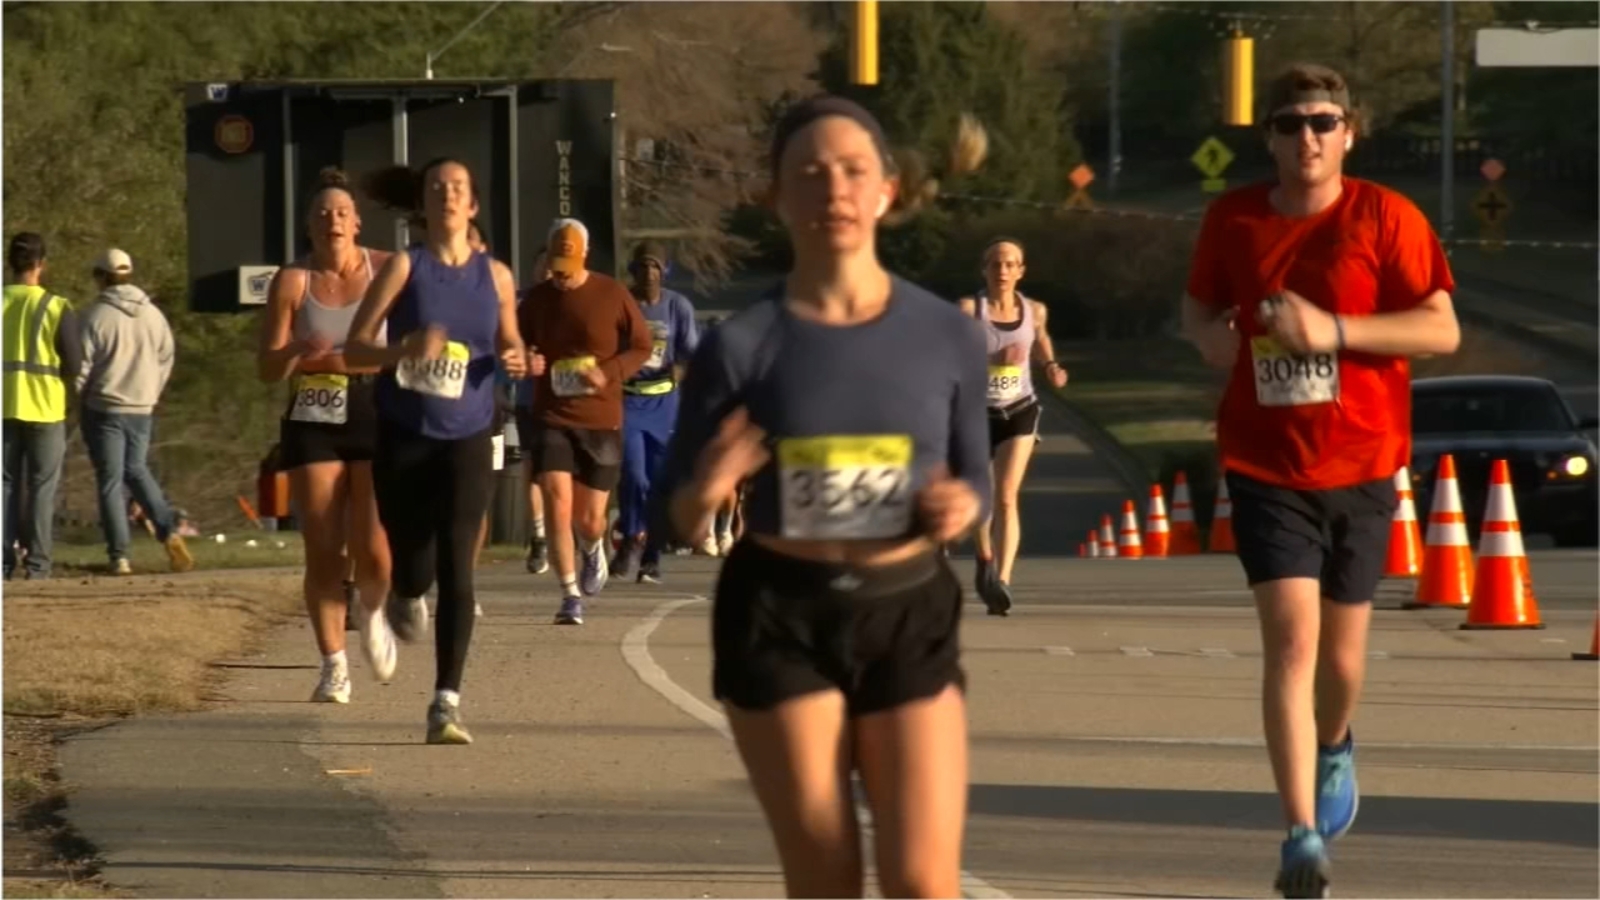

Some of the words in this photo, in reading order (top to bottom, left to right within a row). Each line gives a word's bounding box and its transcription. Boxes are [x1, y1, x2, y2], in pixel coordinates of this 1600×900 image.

[556, 140, 572, 216] WANCO
[403, 357, 462, 380] 88
[1258, 353, 1333, 383] 3048
[791, 469, 906, 509] 3562
